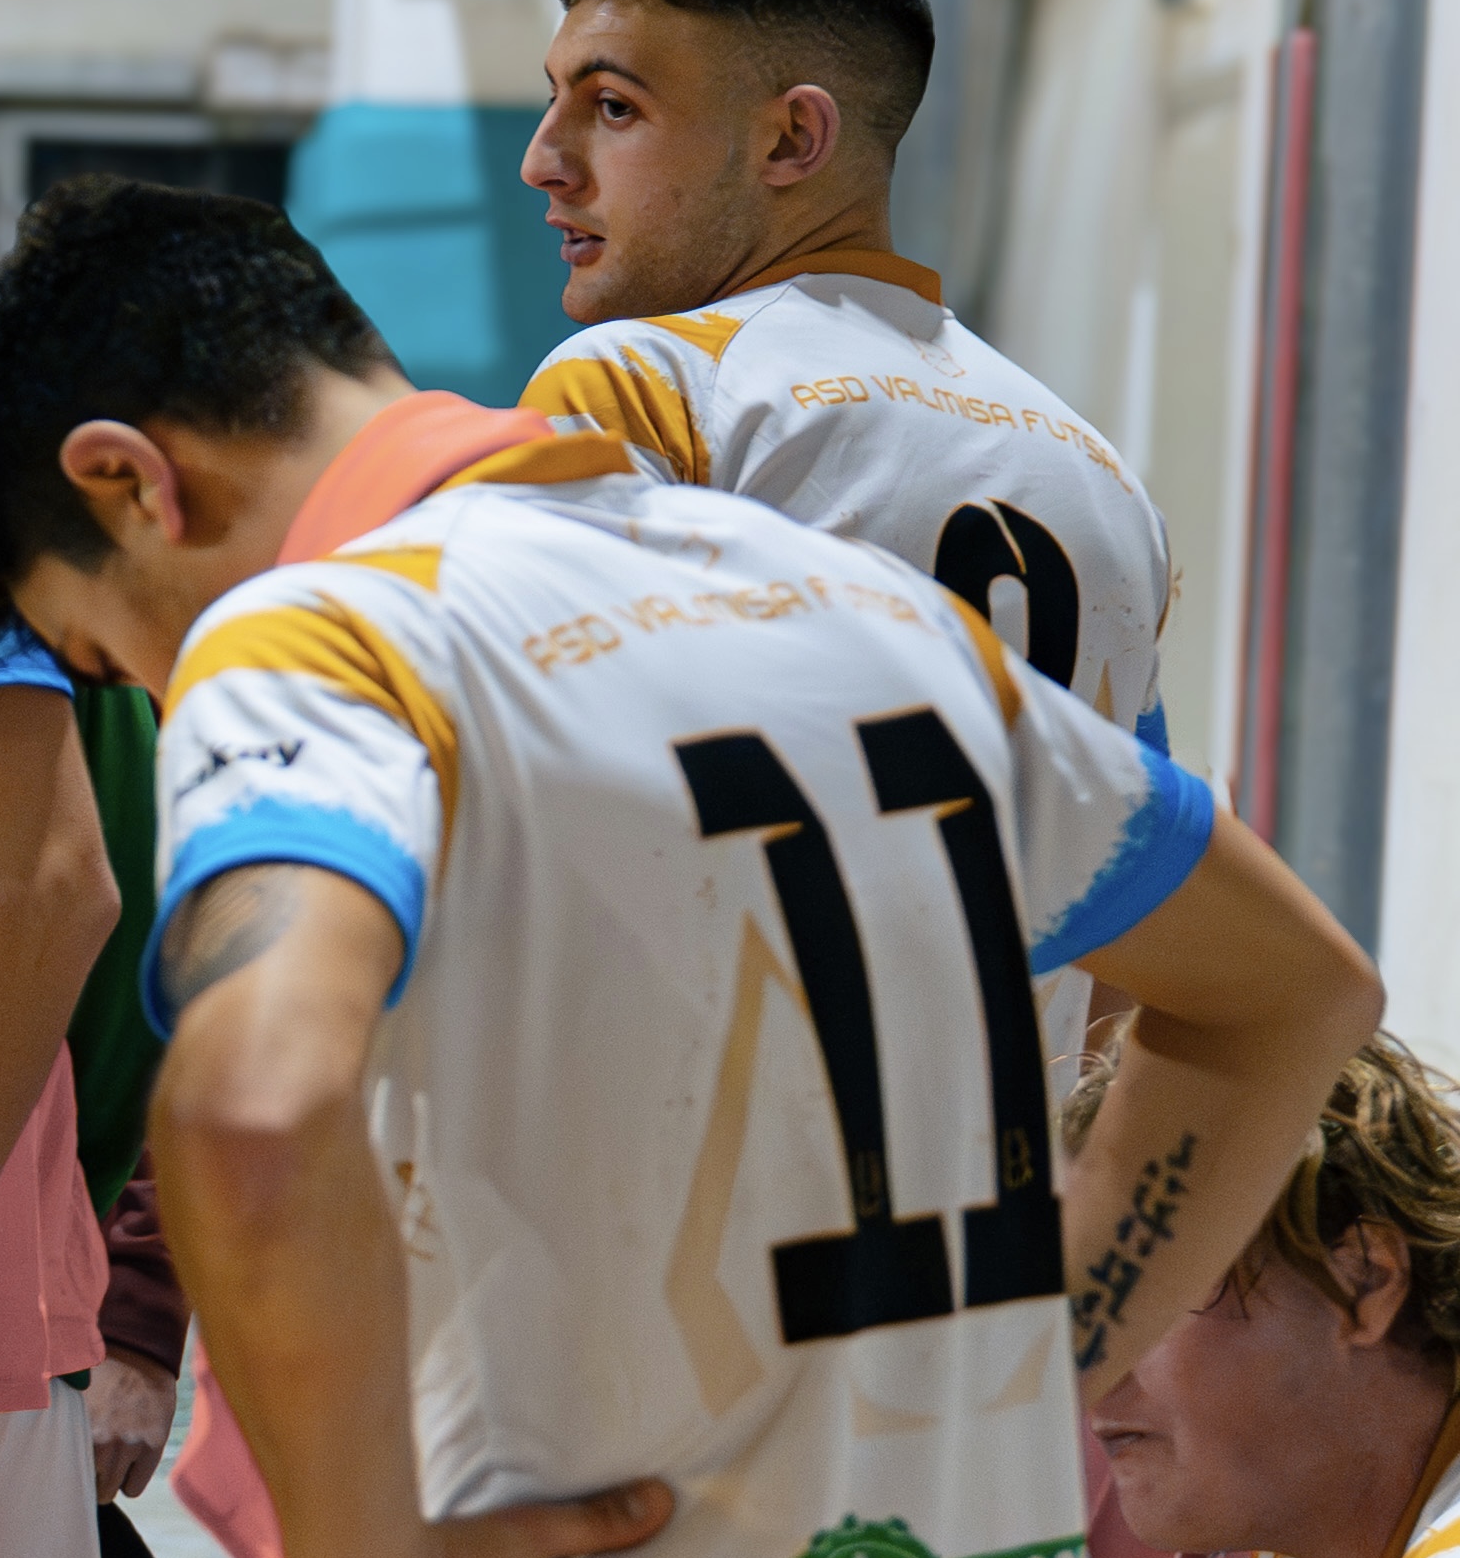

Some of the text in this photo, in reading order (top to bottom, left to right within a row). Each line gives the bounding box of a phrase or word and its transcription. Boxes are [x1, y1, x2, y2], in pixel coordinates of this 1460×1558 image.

[790, 375, 870, 410] ASD
[870, 374, 1018, 429] VALMISA
[670, 704, 1068, 1344] 11
